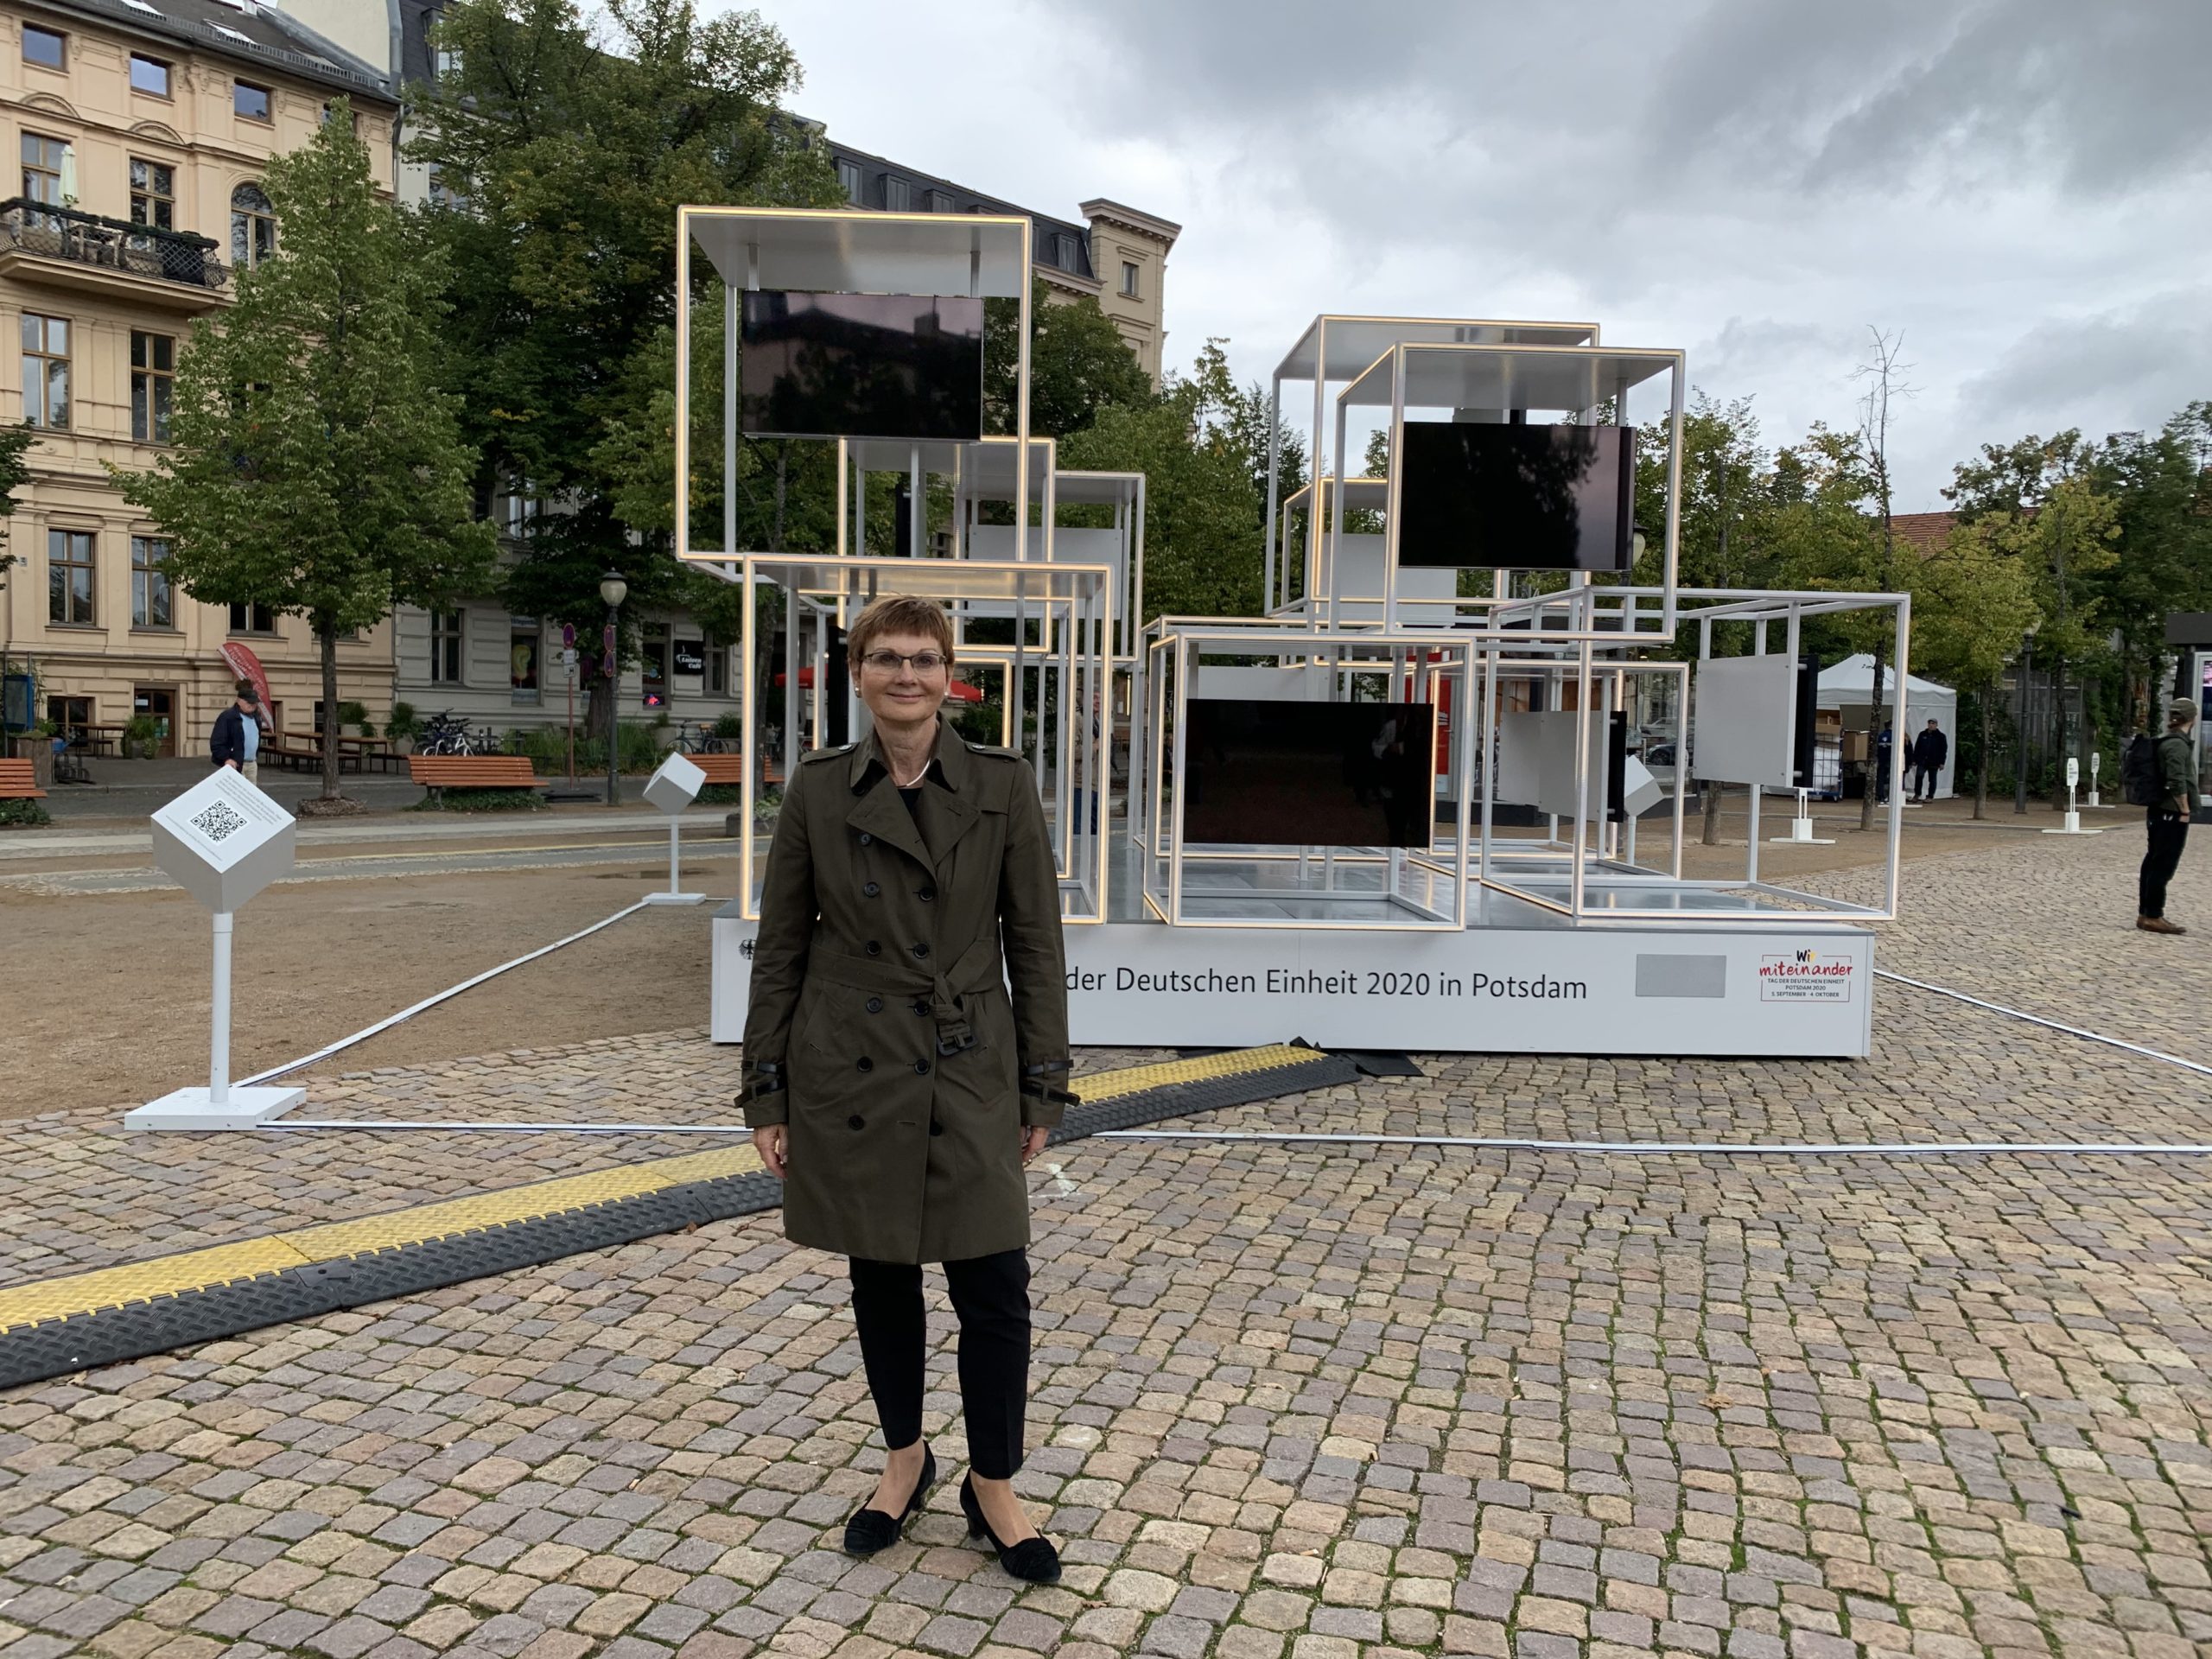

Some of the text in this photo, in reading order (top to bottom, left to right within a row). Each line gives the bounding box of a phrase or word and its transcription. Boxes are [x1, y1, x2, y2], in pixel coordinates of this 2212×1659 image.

[1759, 961, 1853, 976] miteinander
[1065, 966, 1586, 999] der Deutschen Einheit 2020 in Potsdam
